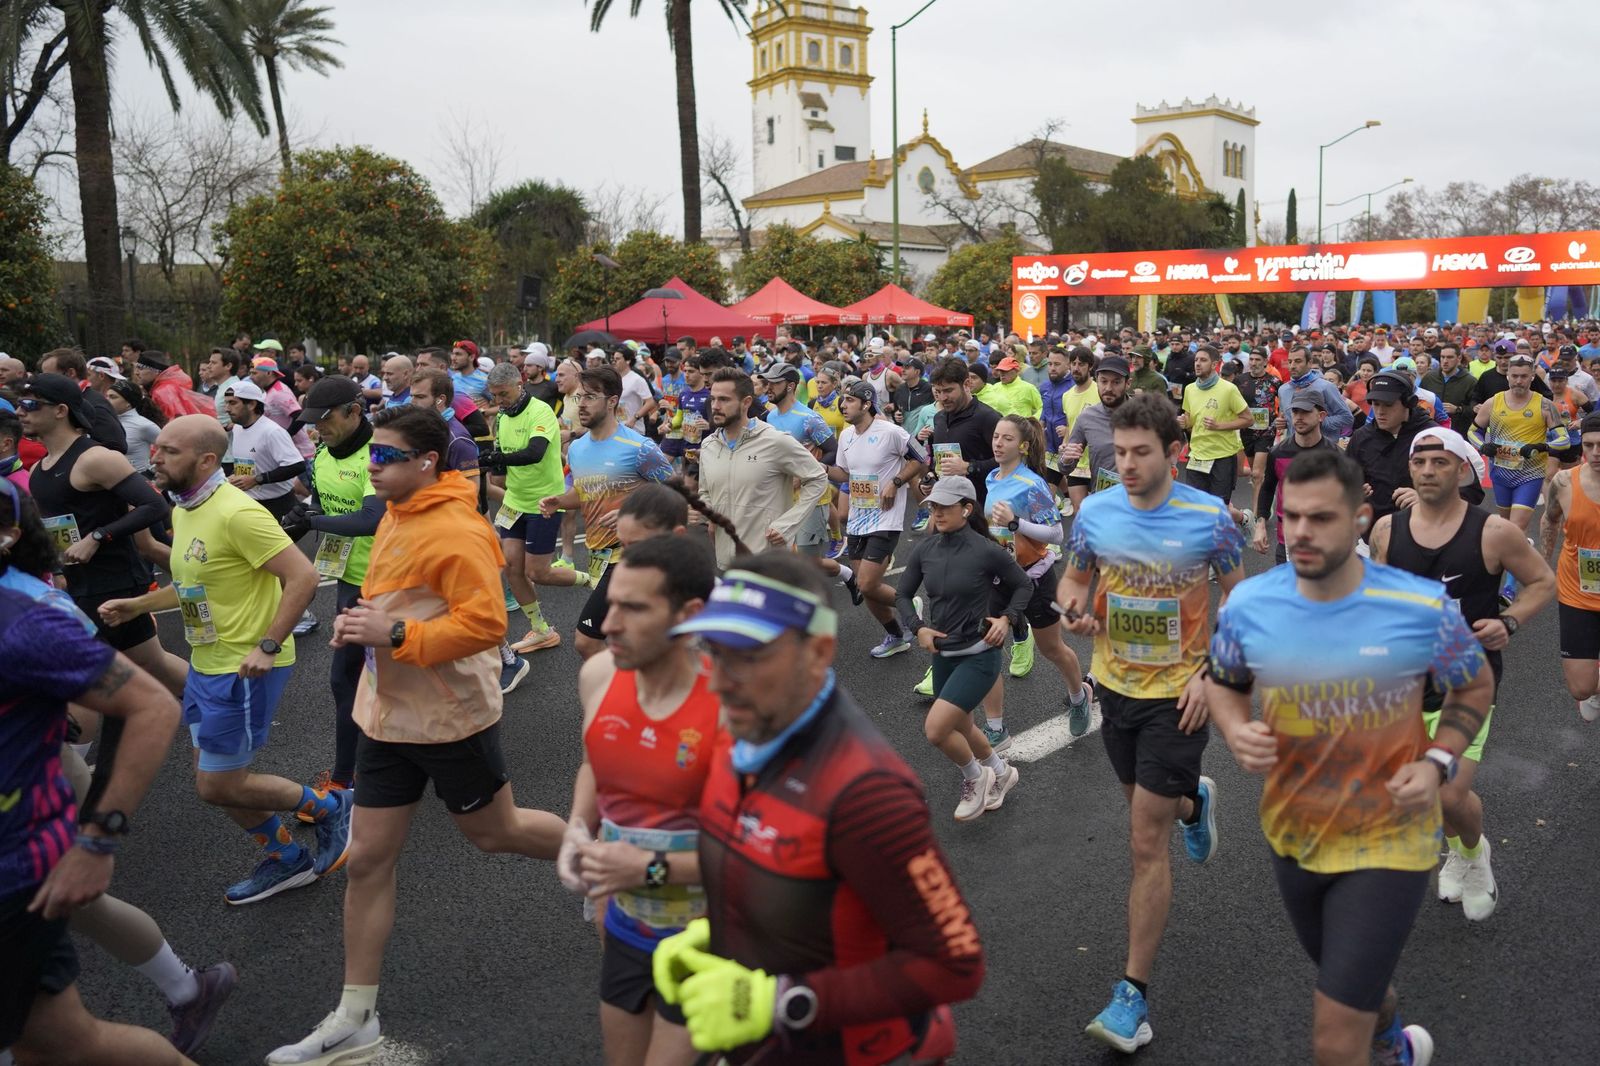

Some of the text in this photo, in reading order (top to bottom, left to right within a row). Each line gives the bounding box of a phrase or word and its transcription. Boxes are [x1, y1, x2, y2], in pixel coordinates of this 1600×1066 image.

[1277, 252, 1344, 268] maratón
[1431, 252, 1488, 271] HOKA
[851, 482, 871, 494] 5935
[1112, 611, 1168, 635] 13055
